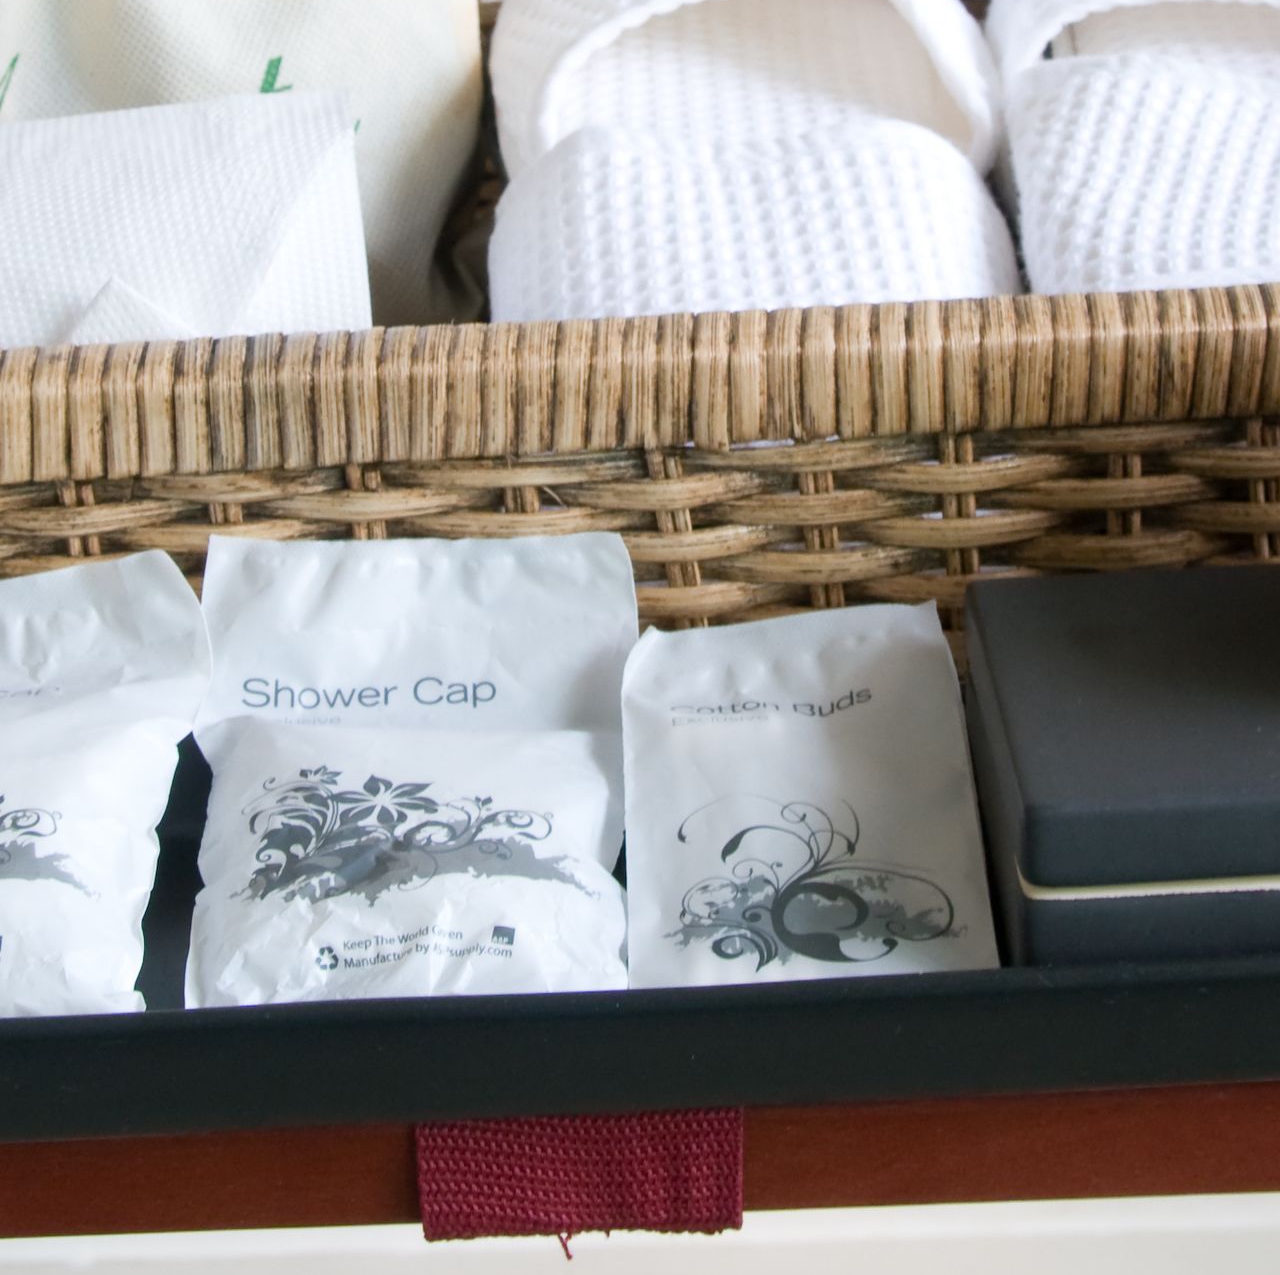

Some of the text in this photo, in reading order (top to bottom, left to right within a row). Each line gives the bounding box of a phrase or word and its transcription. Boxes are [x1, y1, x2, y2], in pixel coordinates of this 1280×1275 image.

[242, 676, 497, 709] Shower Cap
[792, 688, 873, 718] Buds
[343, 937, 372, 951] Keep
[374, 934, 396, 946] The
[397, 925, 430, 944] World
[343, 946, 414, 970] Manufacture
[415, 942, 430, 955] by
